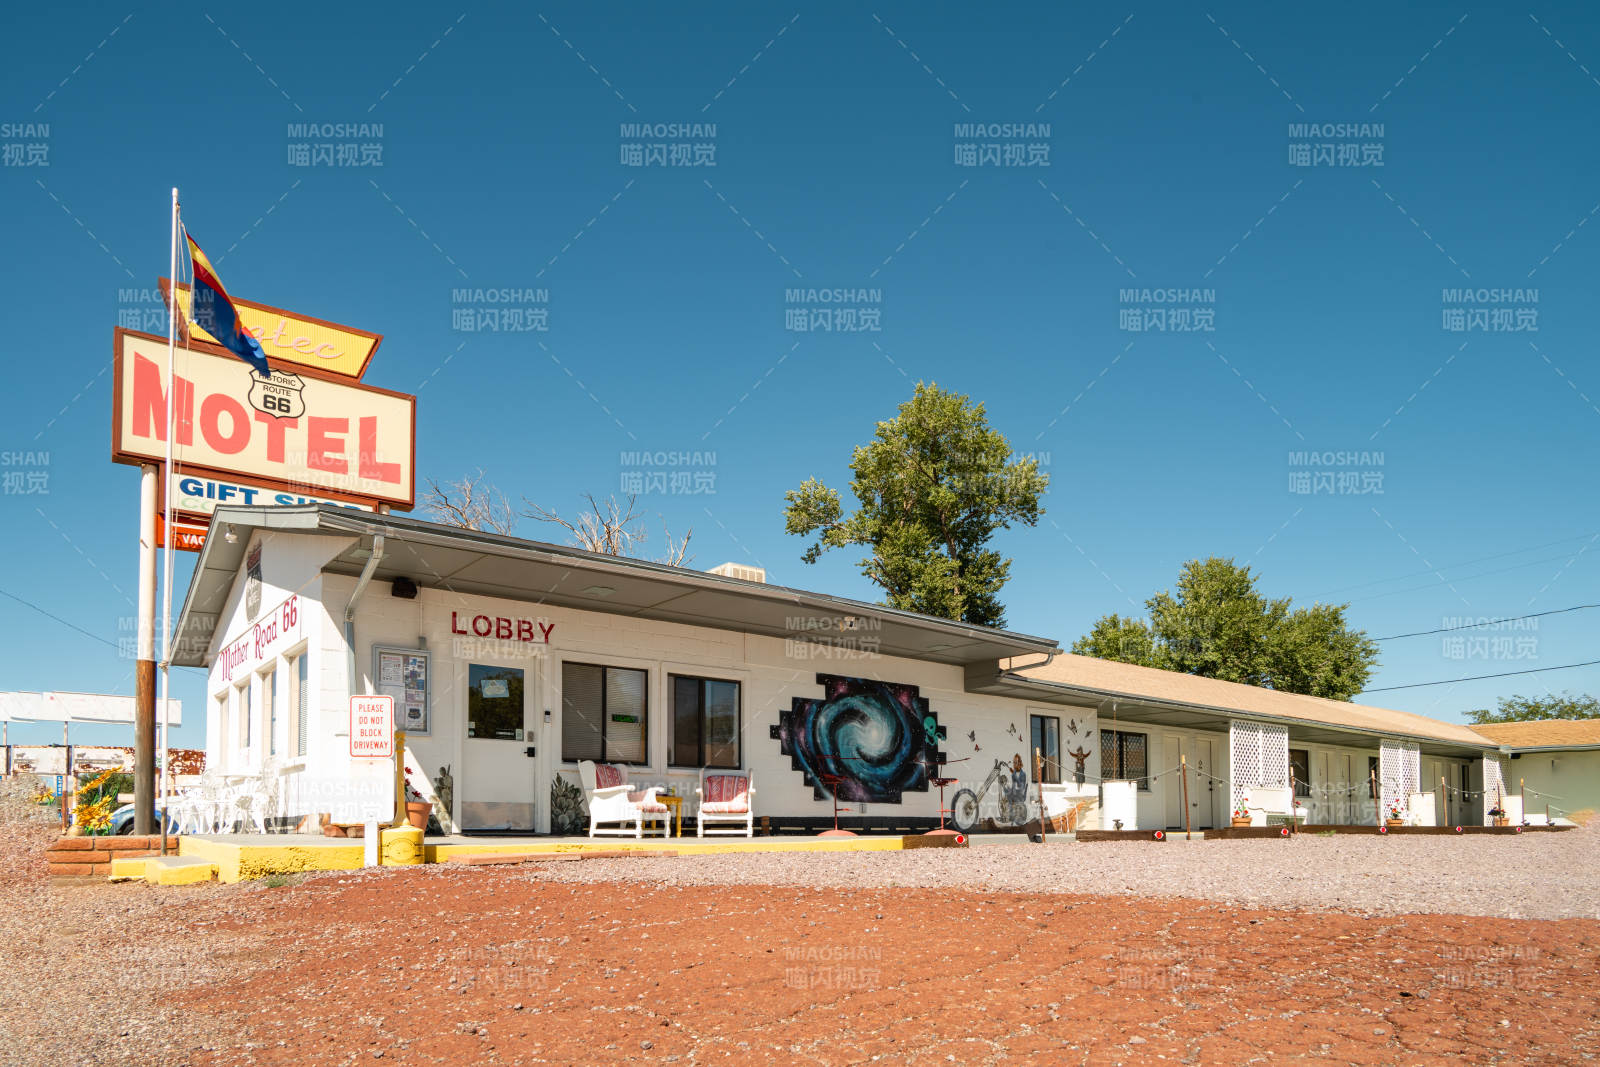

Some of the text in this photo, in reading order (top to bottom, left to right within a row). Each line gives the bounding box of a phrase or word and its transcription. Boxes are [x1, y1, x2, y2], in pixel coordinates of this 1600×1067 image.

[238, 310, 345, 359] ztec
[262, 385, 292, 397] ROUTE
[263, 394, 291, 413] 66
[132, 351, 401, 484] MOTEL
[179, 478, 259, 505] GIFT
[451, 611, 555, 644] LOBBY
[219, 595, 297, 682] Mother Road 66
[358, 703, 384, 712] PLEASE
[359, 716, 384, 725] DO NOT
[360, 728, 382, 737] BLOCK
[353, 740, 389, 749] DRIVEWAY
